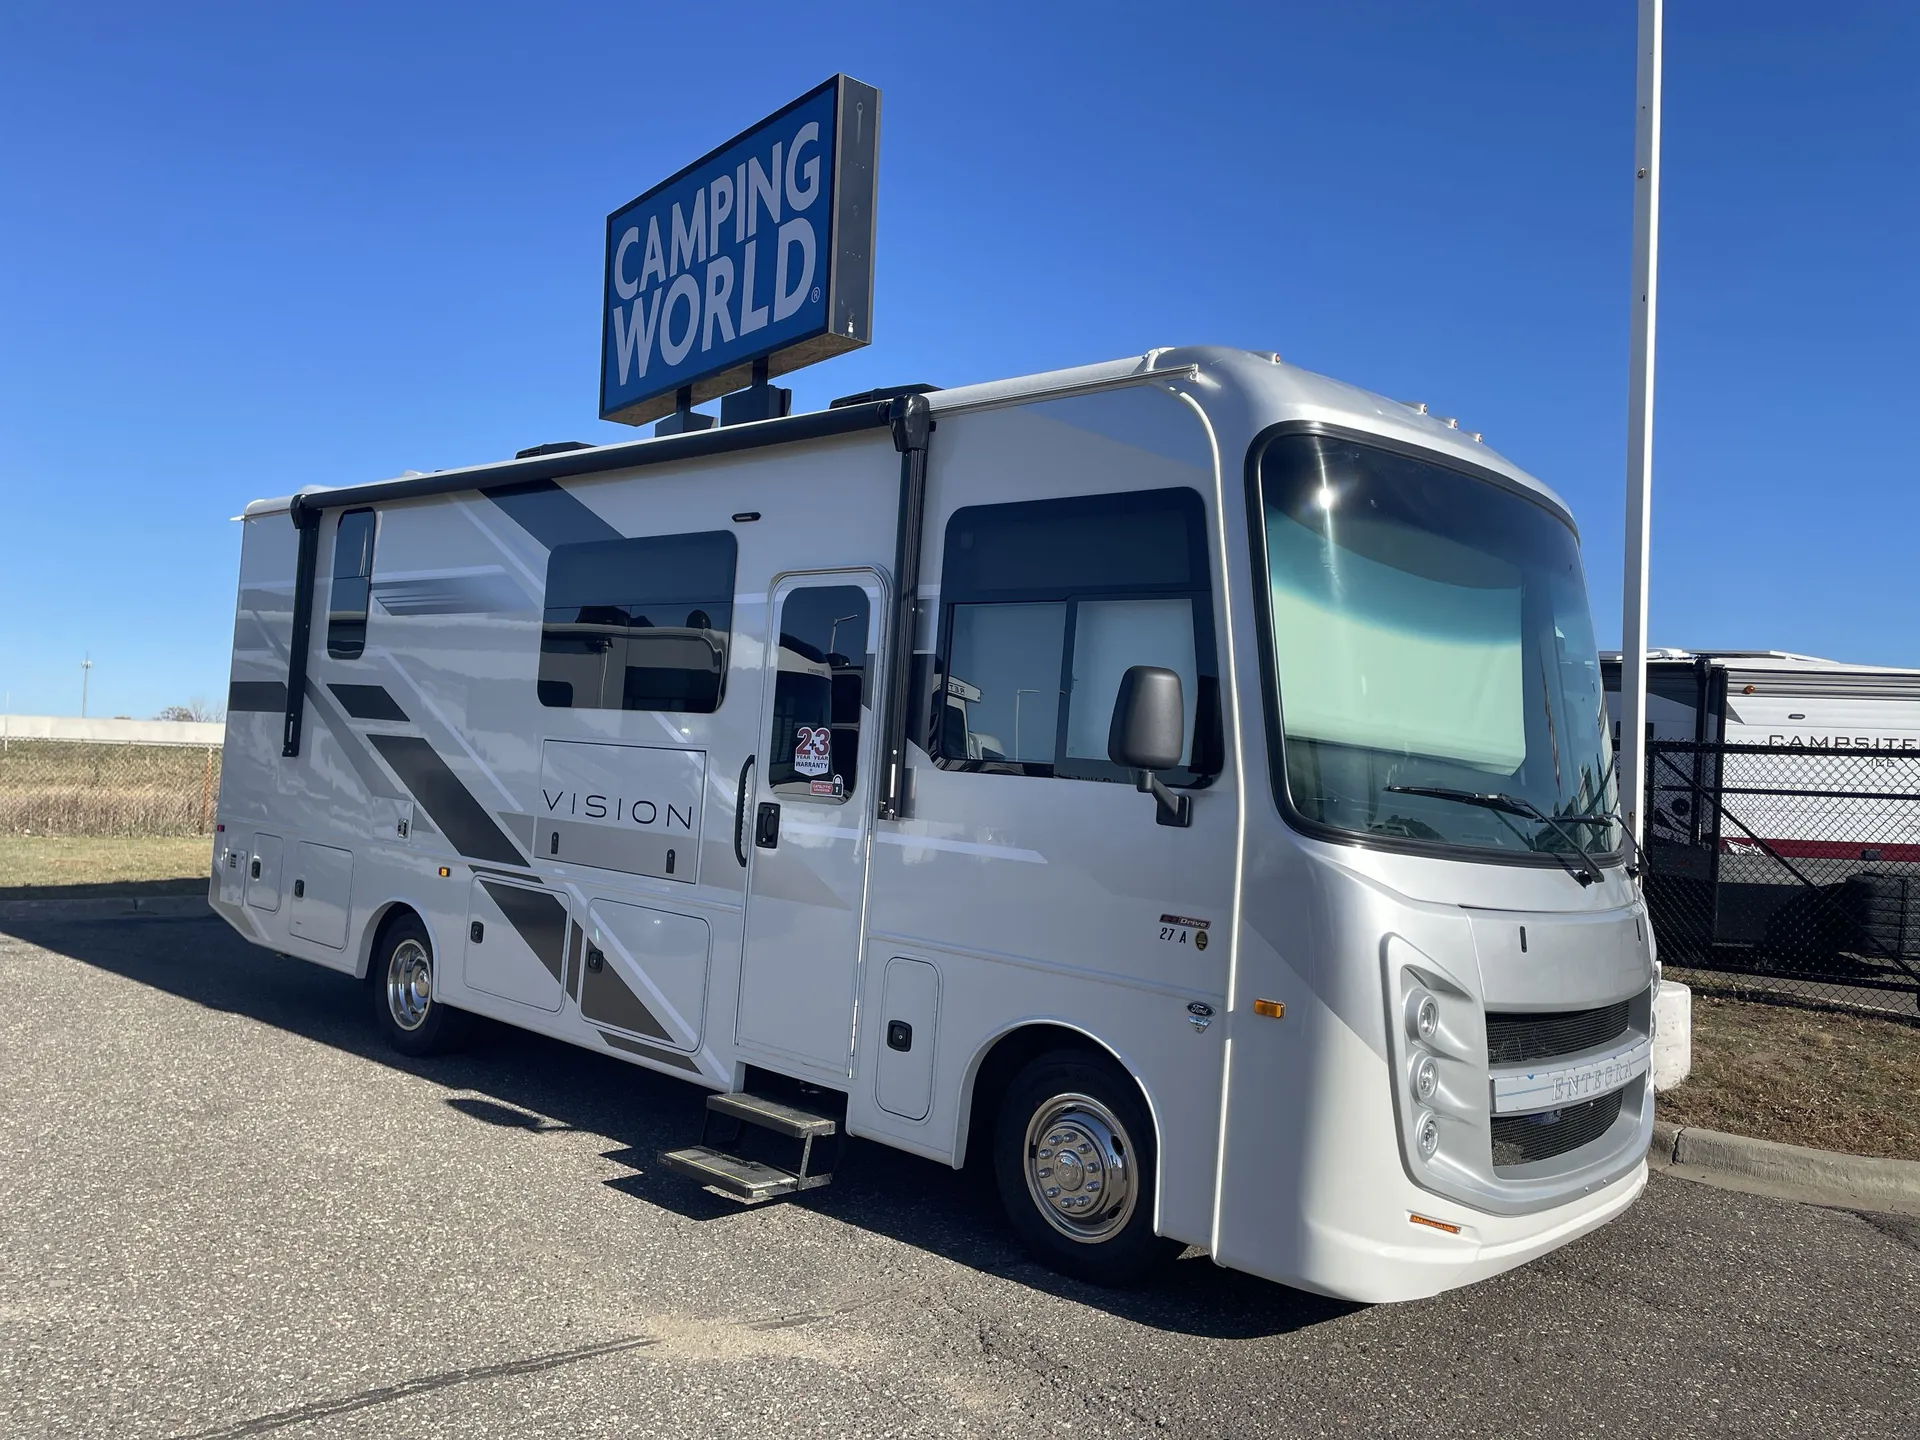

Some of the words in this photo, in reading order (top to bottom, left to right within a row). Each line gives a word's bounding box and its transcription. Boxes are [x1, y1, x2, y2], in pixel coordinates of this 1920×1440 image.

[614, 121, 821, 300] CAMPING
[613, 217, 817, 386] WORLD
[1769, 735, 1917, 749] CAMPSITE
[796, 761, 828, 769] WARRANTY
[542, 789, 692, 830] VISION
[1159, 927, 1175, 941] 27
[1179, 930, 1187, 944] A
[1180, 918, 1207, 927] Drive
[1552, 1059, 1633, 1101] ENTEGRA
